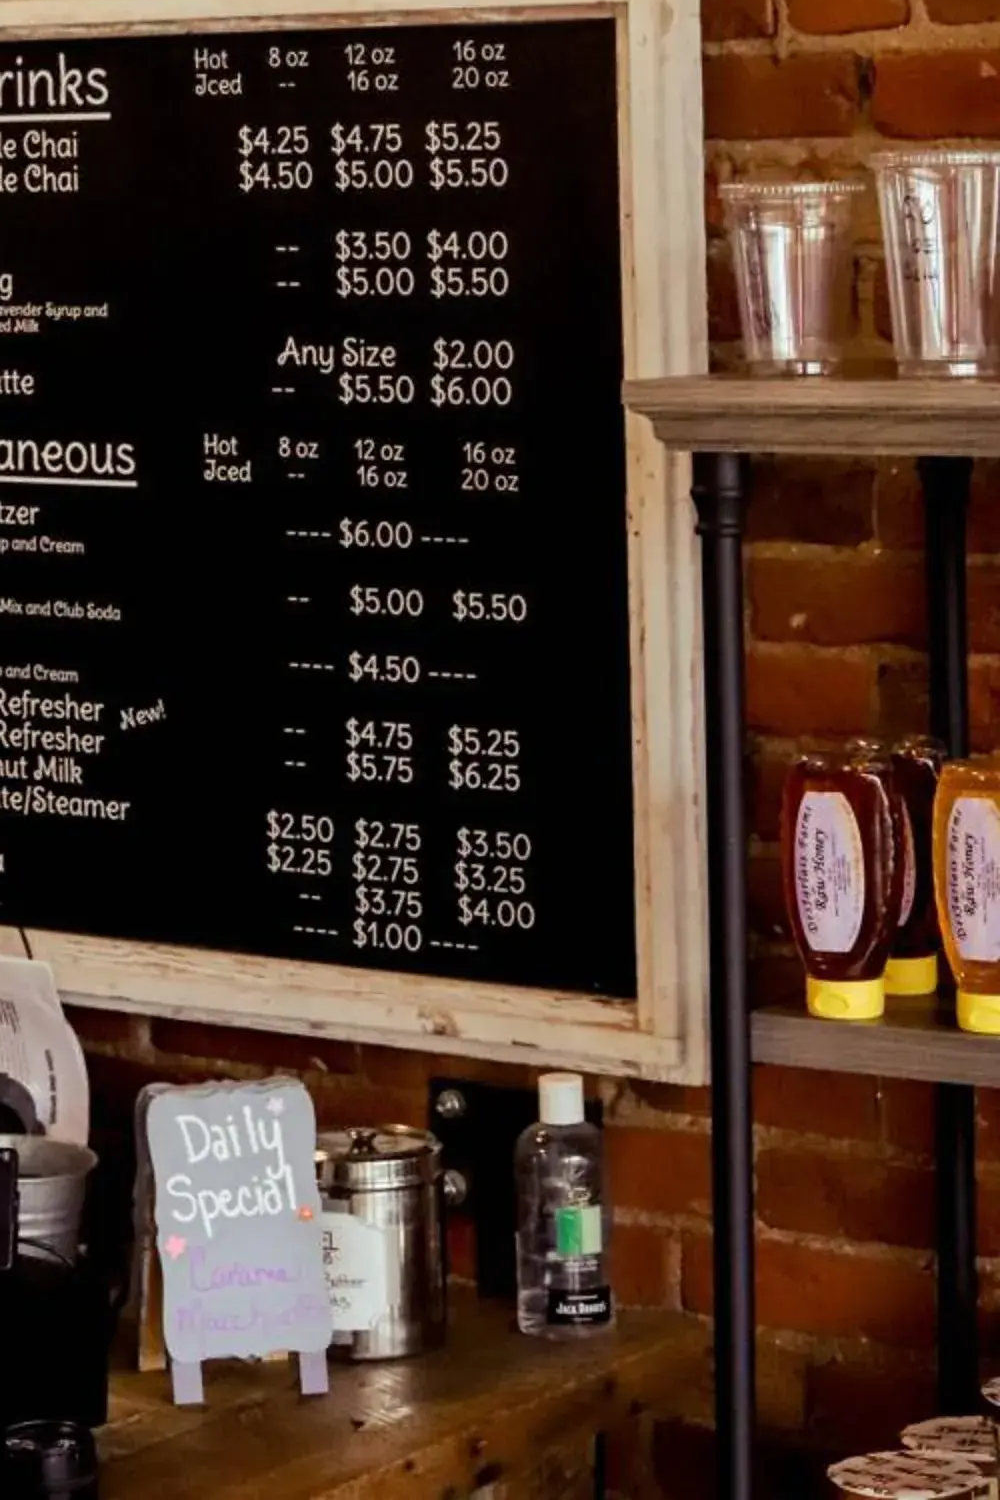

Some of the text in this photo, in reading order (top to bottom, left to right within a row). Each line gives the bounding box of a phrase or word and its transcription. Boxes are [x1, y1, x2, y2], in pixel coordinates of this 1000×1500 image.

[268, 46, 309, 68] 8 oz
[22, 129, 78, 159] Chai
[425, 120, 501, 155] $5.25
[276, 336, 397, 375] Any Size
[349, 584, 424, 617] $5.00
[33, 754, 83, 785] Milk
[354, 817, 422, 851] $2.75
[352, 917, 423, 952] $1.00
[175, 1105, 284, 1180] Daily
[166, 1165, 296, 1238] Special
